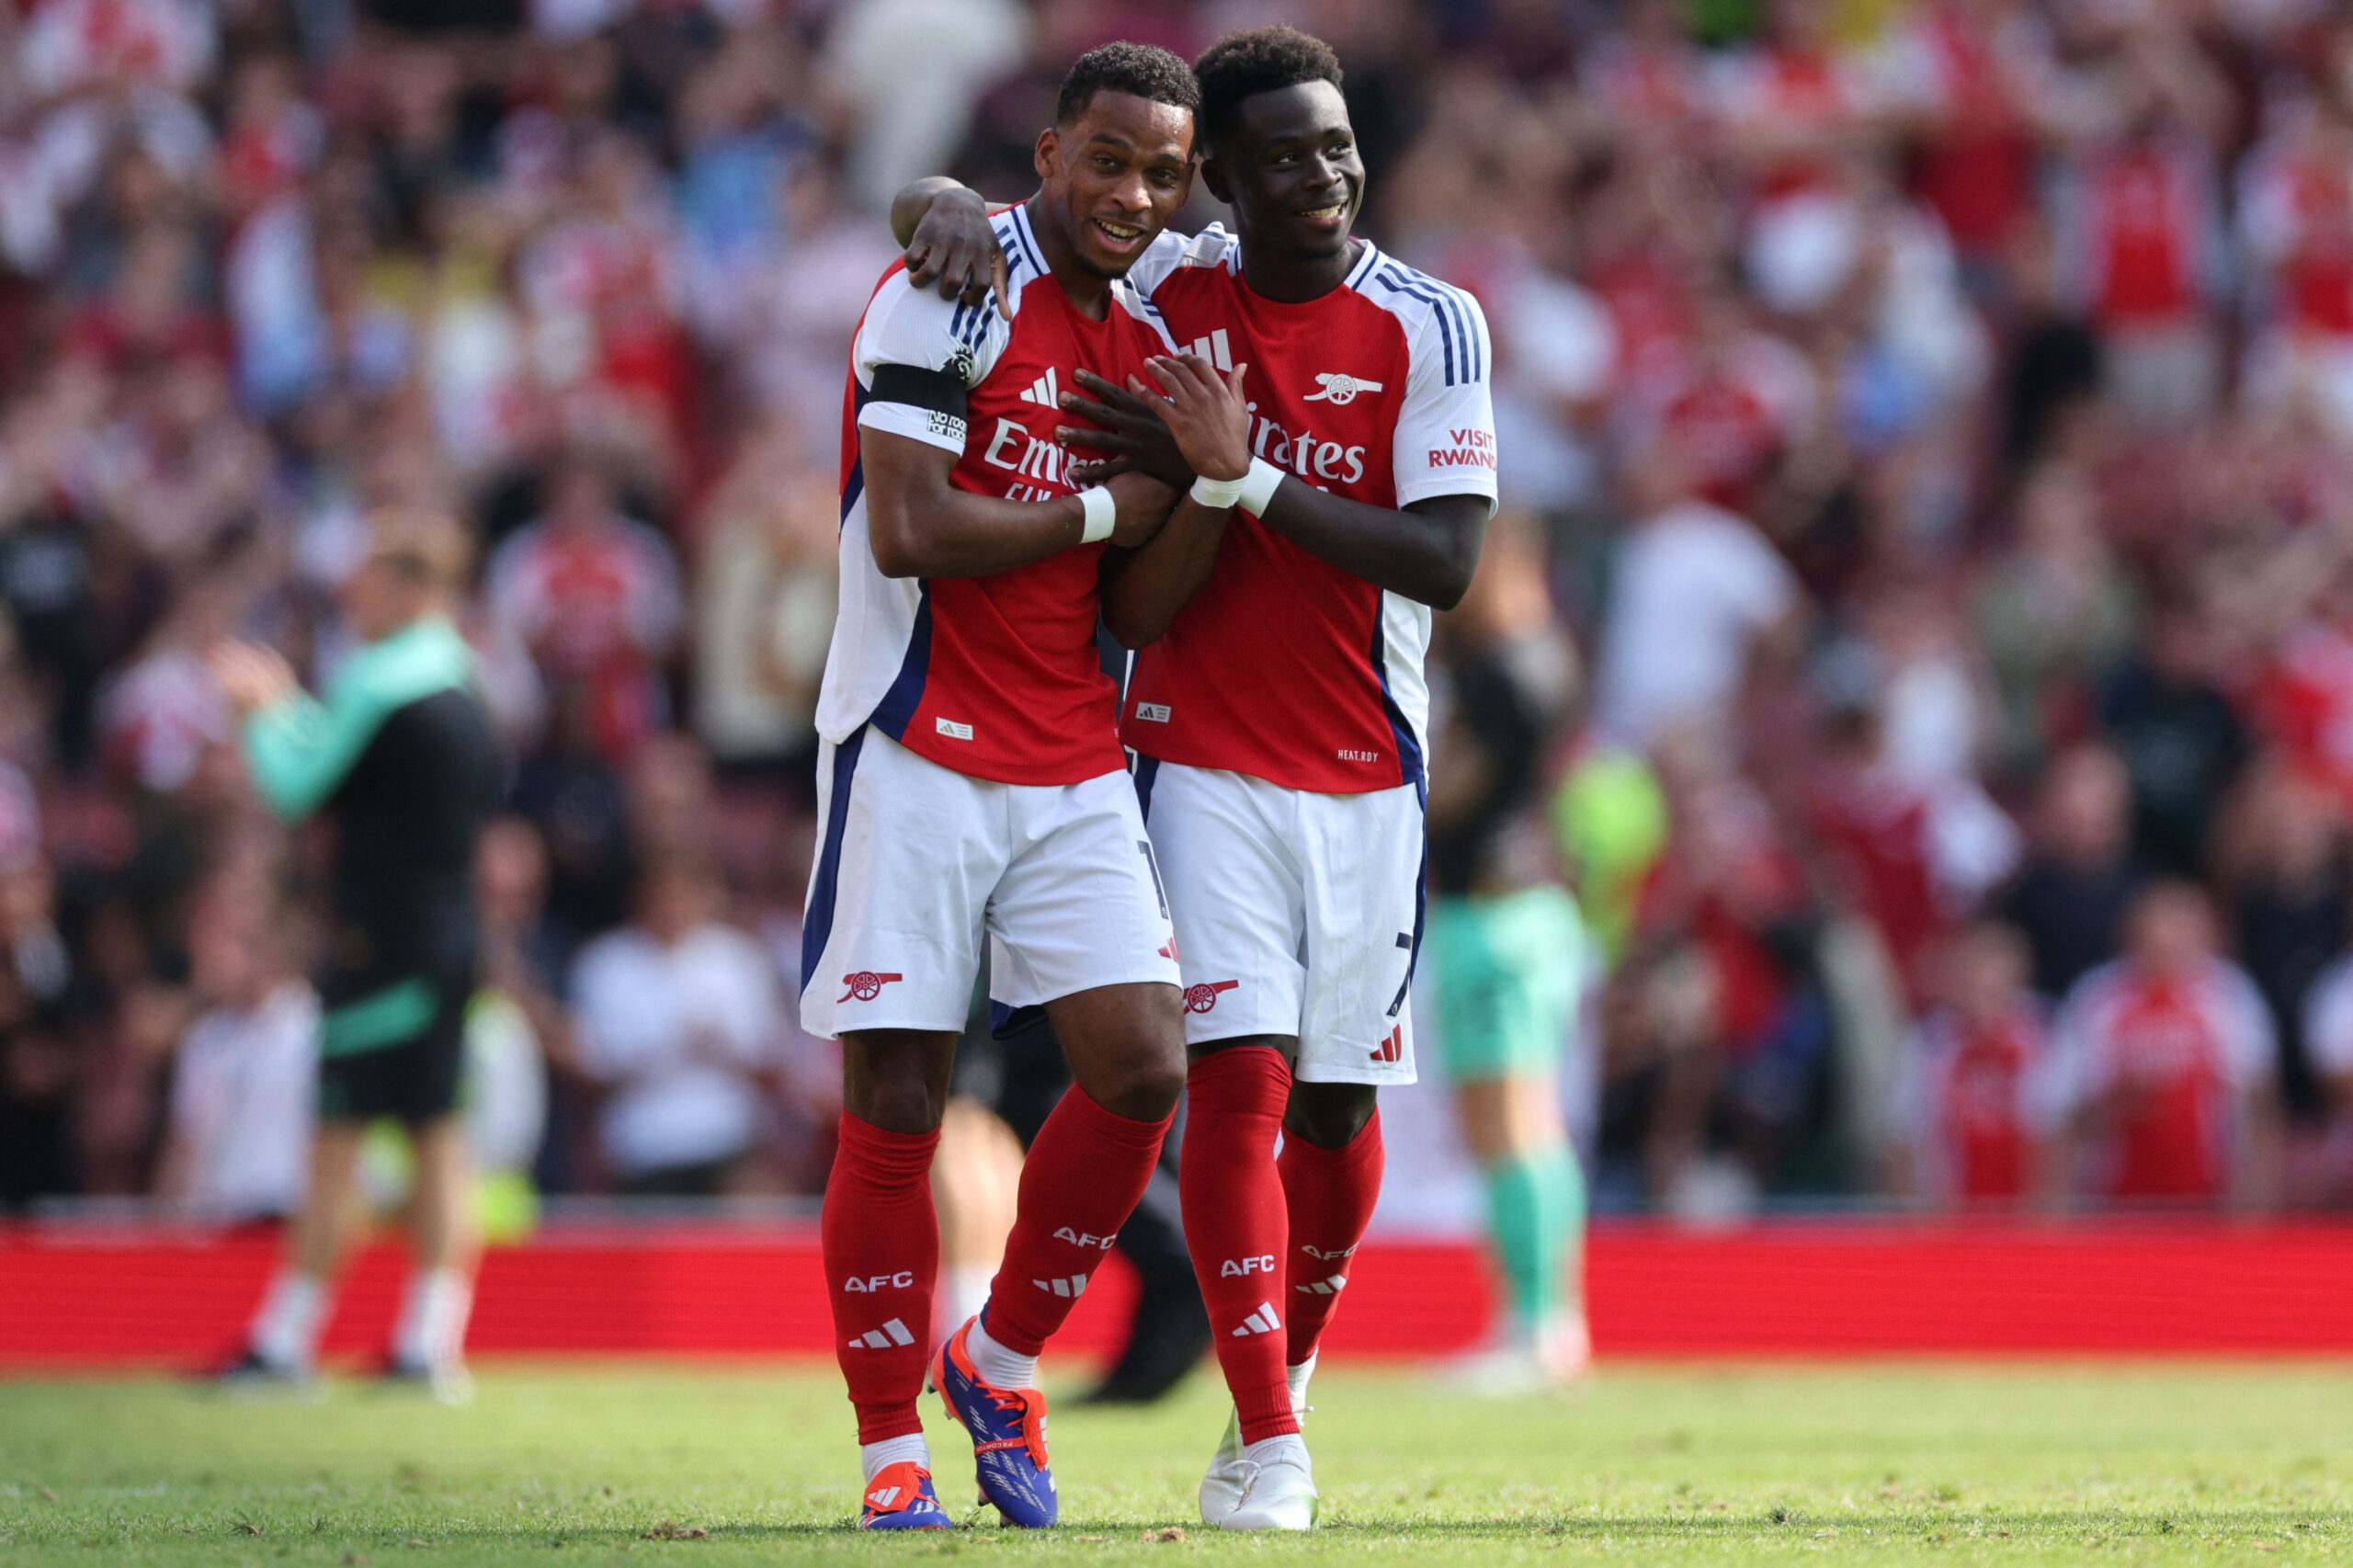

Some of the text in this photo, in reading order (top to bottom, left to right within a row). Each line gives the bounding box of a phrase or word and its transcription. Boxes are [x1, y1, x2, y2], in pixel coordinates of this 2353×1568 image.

[928, 410, 967, 432] No roo
[1247, 402, 1366, 483] irates
[1449, 429, 1493, 450] VISIT
[1428, 449, 1496, 472] RWAND
[1337, 749, 1379, 763] HEAT.RDY
[1052, 1227, 1117, 1250] AFC
[1221, 1255, 1275, 1278] AFC
[845, 1270, 913, 1292] AFC
